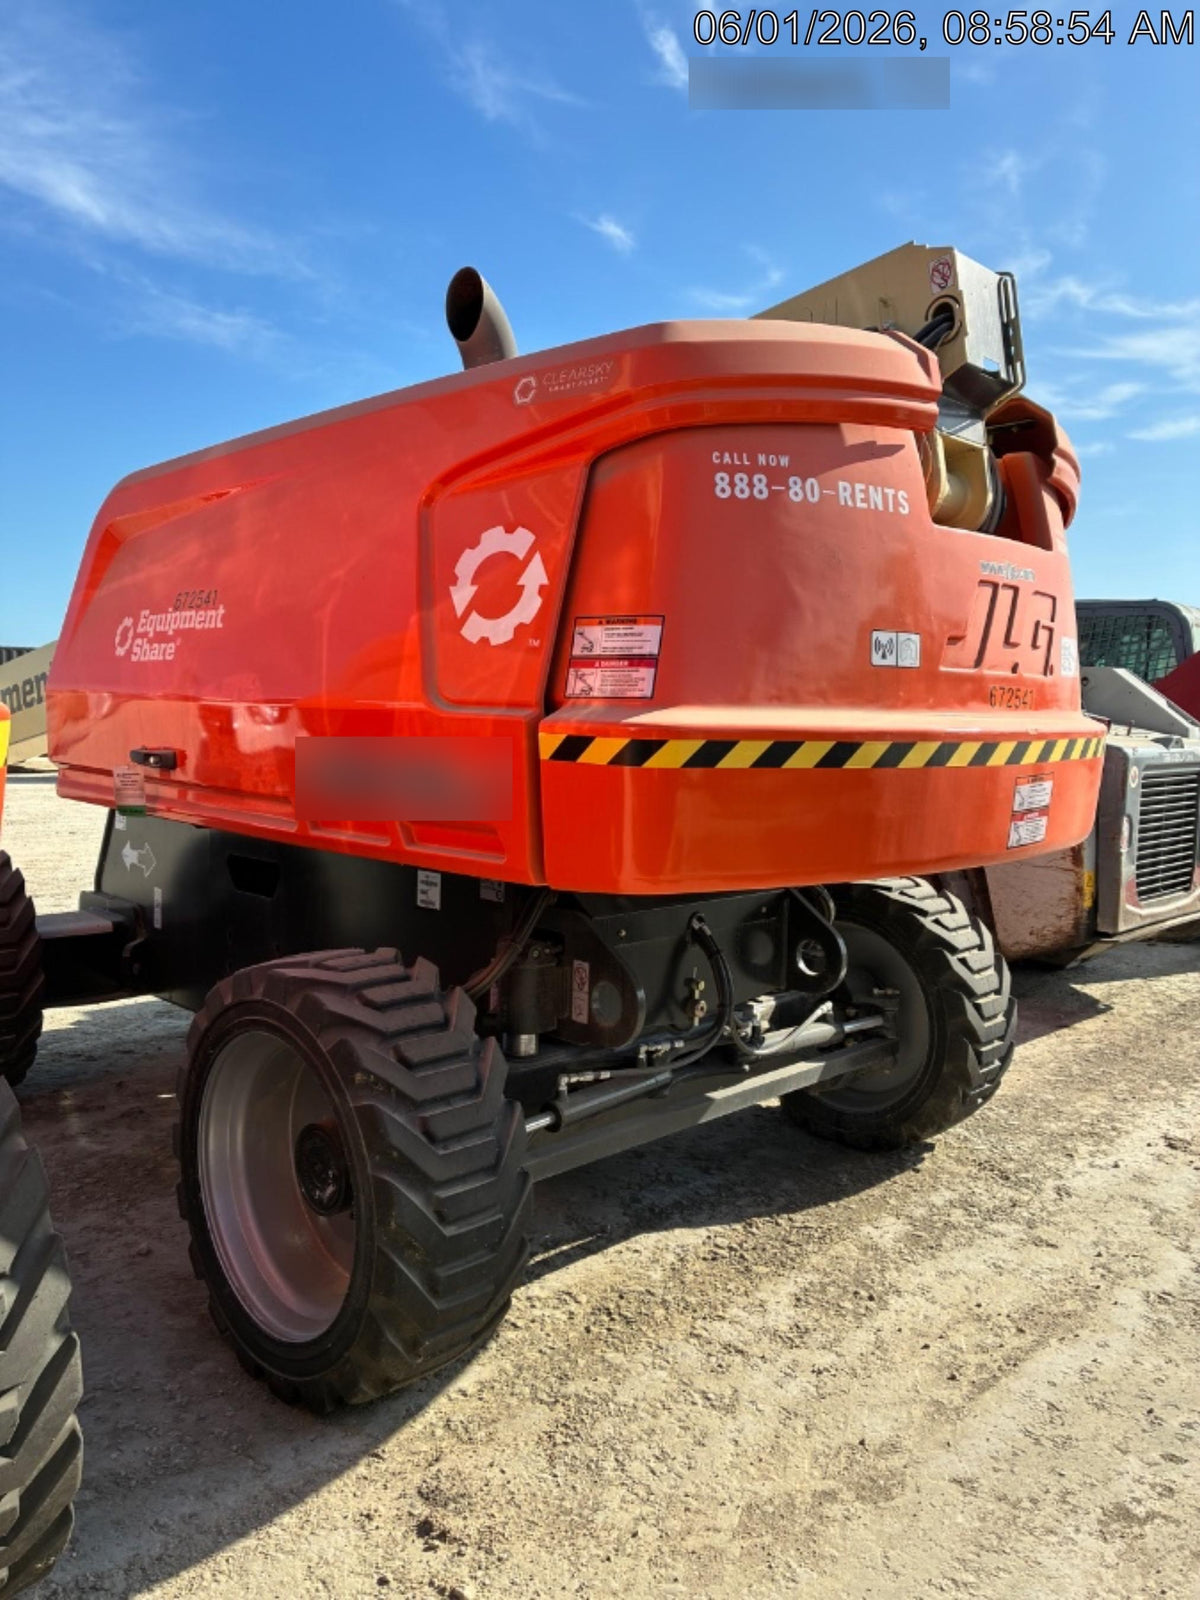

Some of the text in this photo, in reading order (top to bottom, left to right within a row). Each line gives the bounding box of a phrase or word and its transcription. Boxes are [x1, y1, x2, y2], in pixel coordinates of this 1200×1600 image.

[712, 451, 790, 468] CALL NOW
[714, 472, 910, 515] 888-80-RENTS
[174, 589, 218, 611] 672541
[136, 604, 225, 638] Equipment
[131, 638, 176, 662] Share
[989, 685, 1034, 710] 672541
